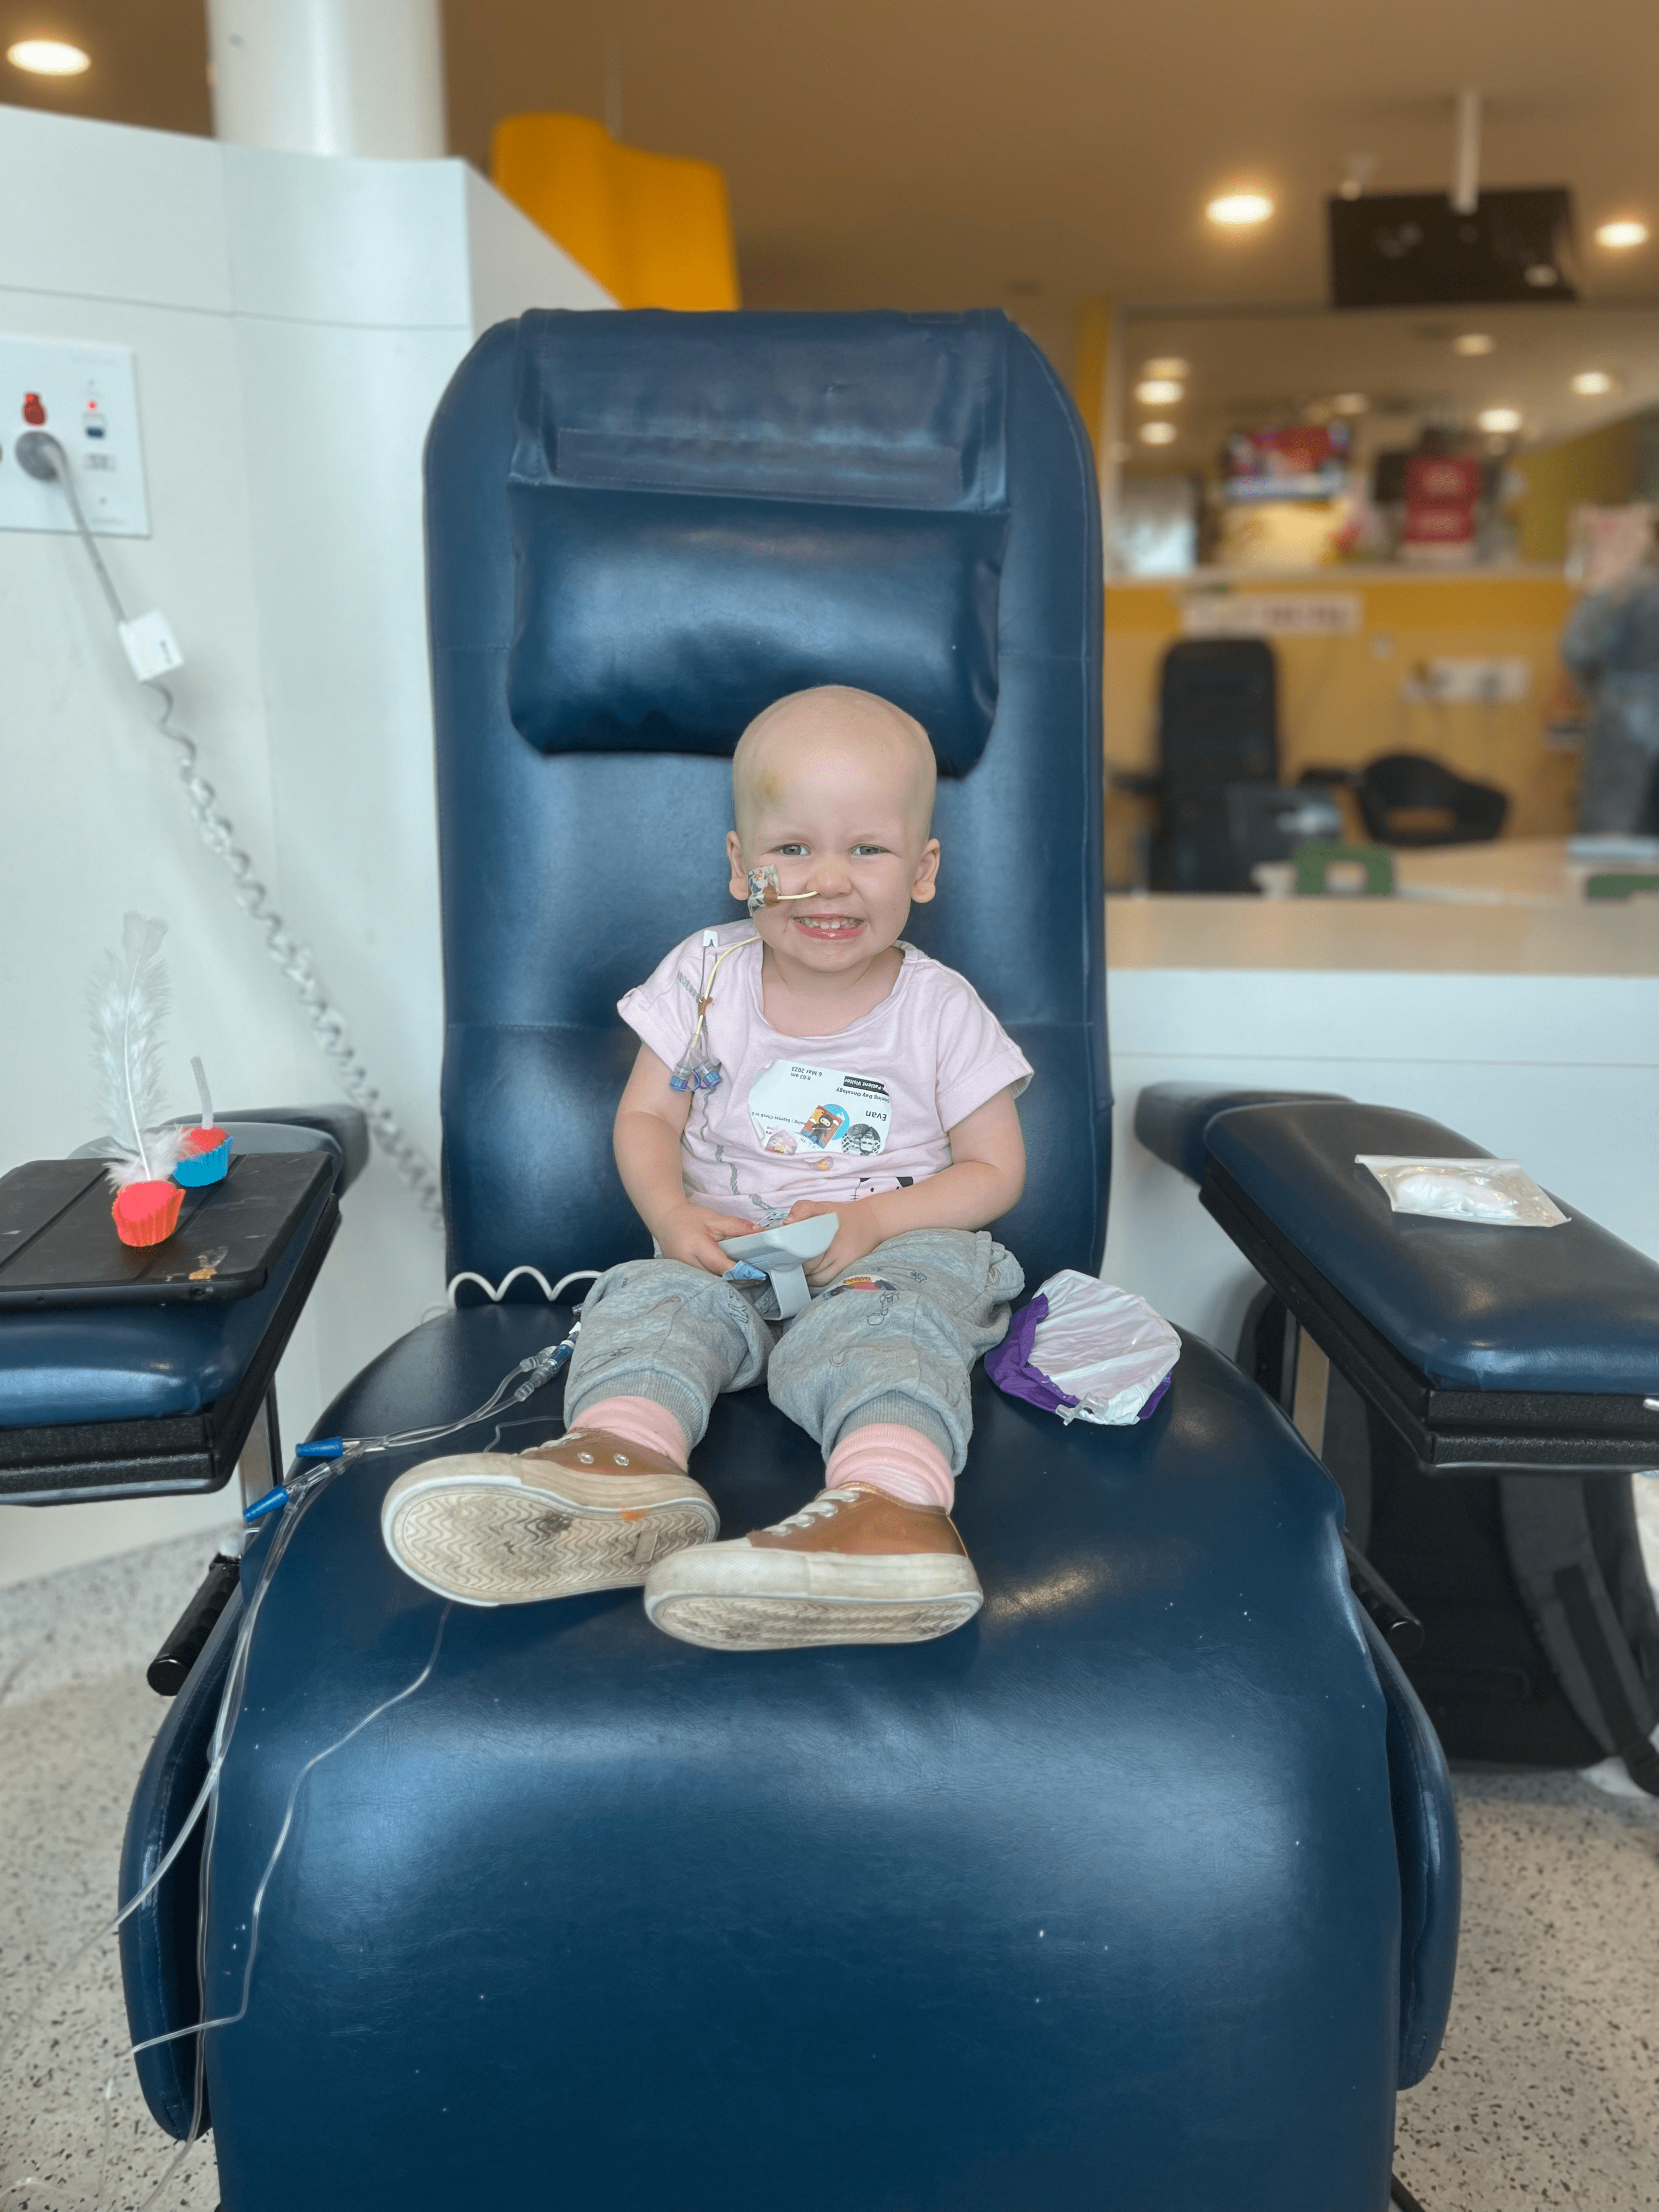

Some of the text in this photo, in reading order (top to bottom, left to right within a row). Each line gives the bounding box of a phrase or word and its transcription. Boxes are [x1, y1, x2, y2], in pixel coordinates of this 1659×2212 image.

[836, 1087, 861, 1097] Oncology
[874, 1094, 889, 1103] Seeing
[865, 1111, 886, 1121] Evan
